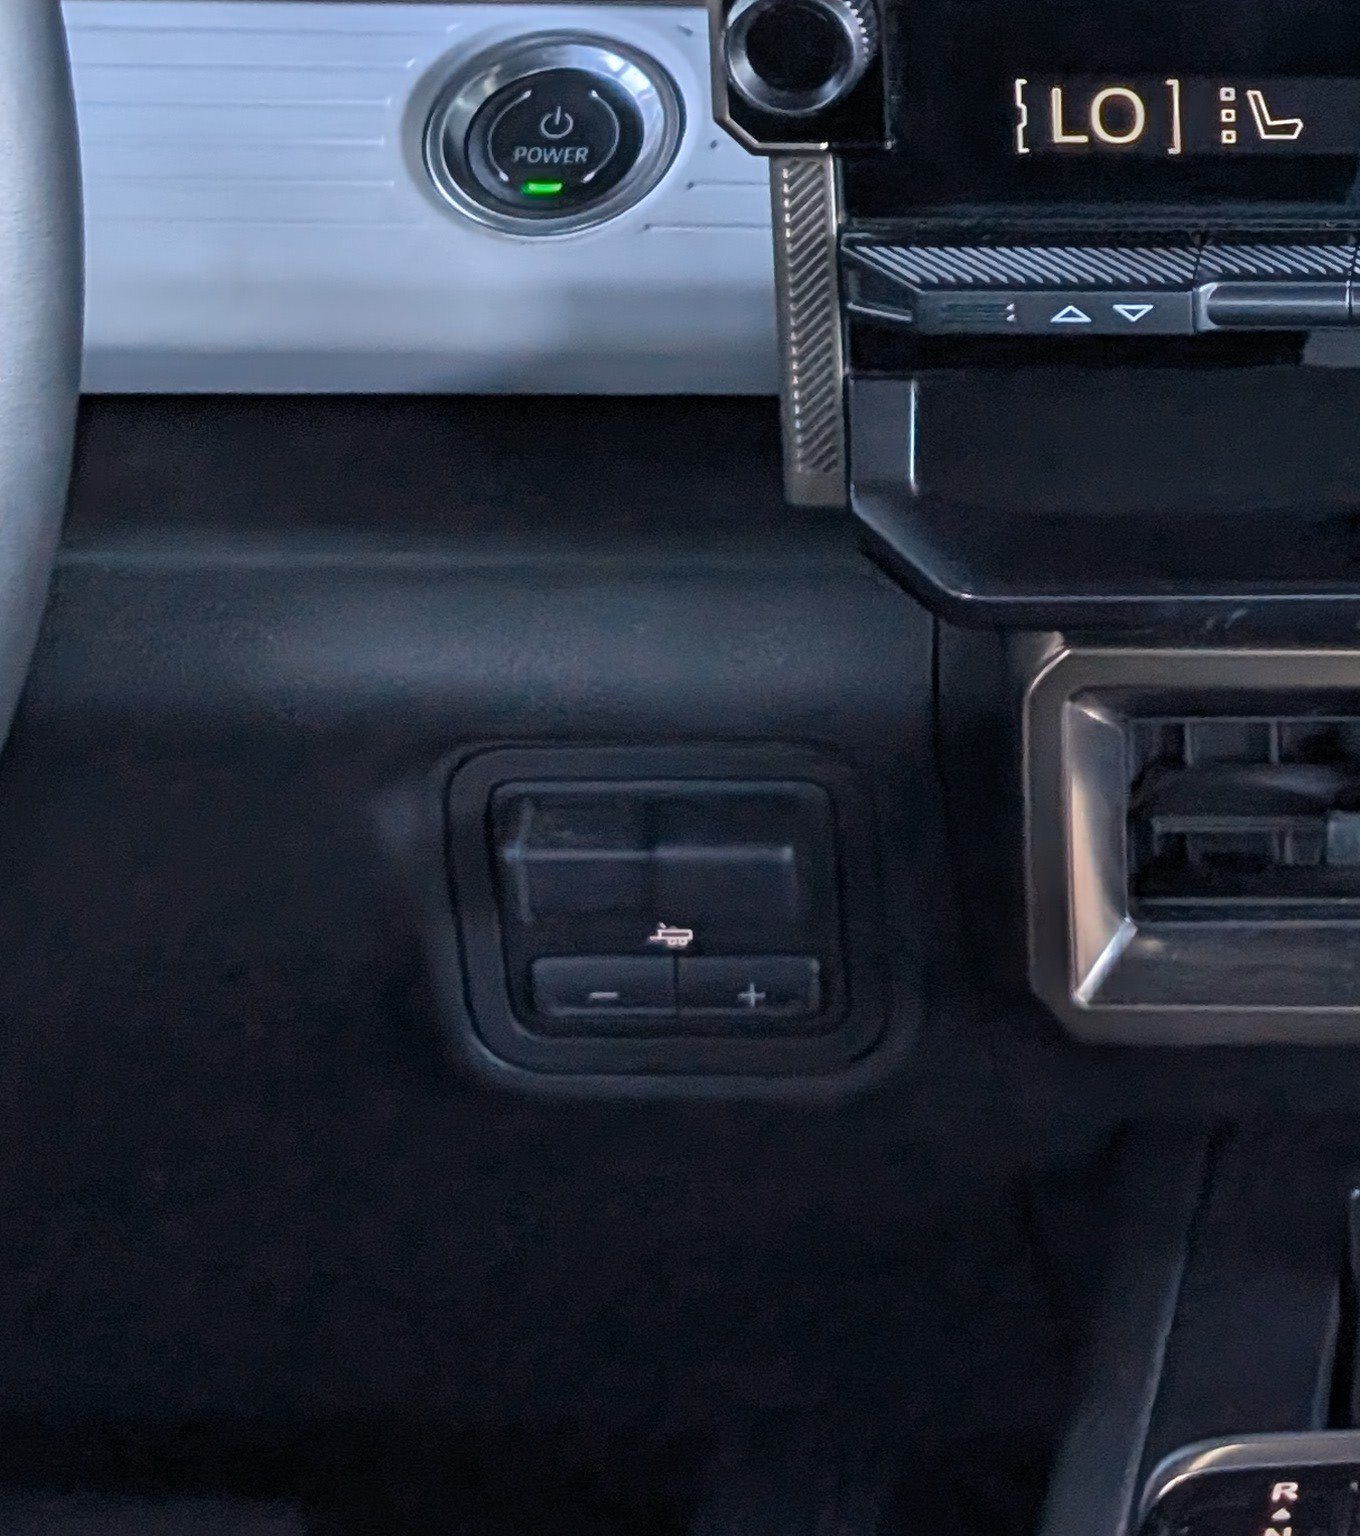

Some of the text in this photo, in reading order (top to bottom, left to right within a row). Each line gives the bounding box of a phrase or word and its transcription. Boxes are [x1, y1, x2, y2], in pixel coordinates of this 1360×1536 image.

[1051, 87, 1146, 144] LO
[513, 146, 590, 164] POWER
[1271, 1481, 1299, 1502] R
